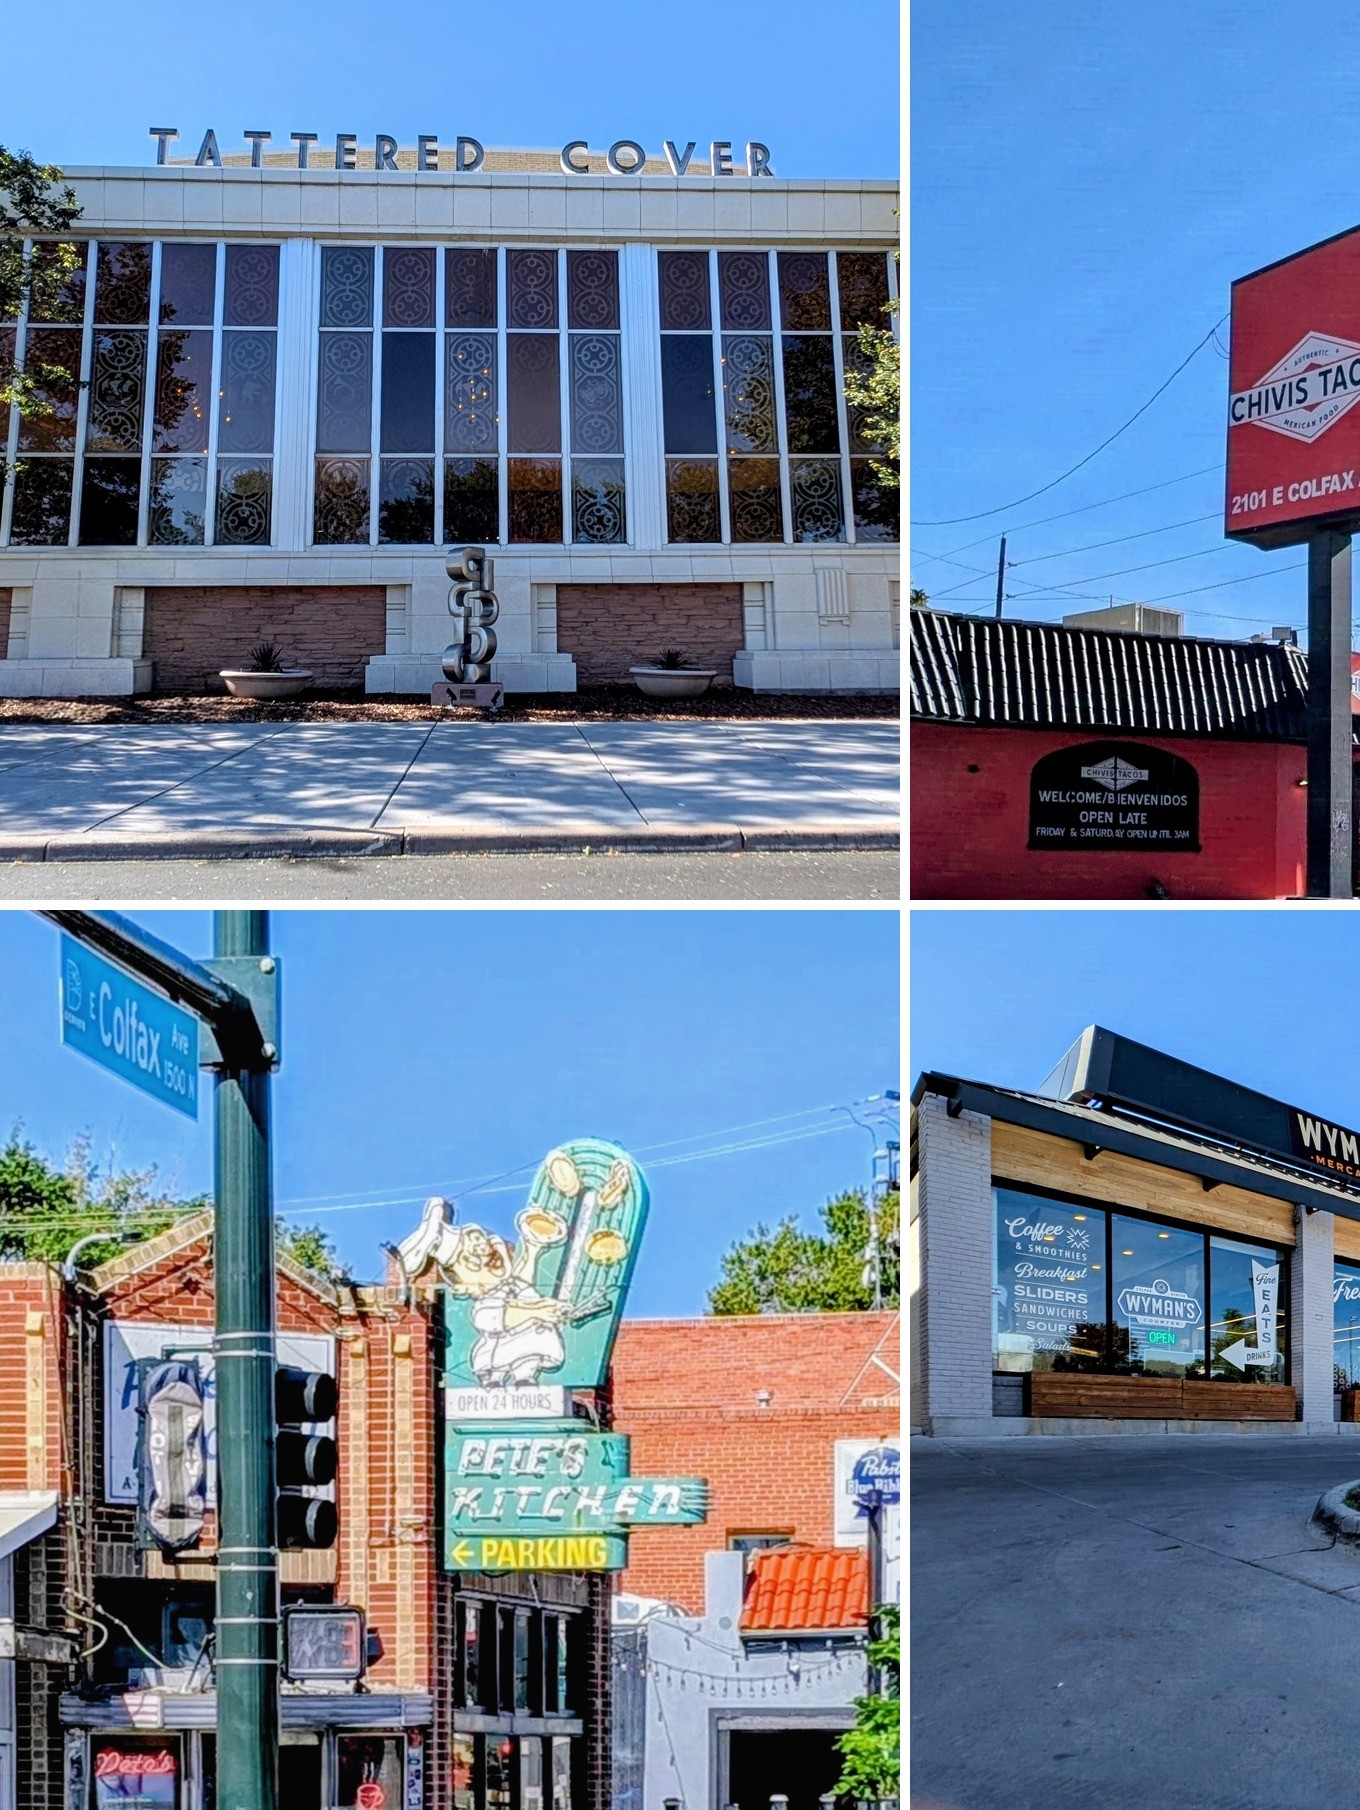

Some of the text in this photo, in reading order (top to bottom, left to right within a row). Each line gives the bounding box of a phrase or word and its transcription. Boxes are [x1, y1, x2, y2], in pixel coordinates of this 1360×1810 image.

[149, 127, 775, 177] TATTERED COVER
[1294, 349, 1329, 368] AUTHENTIC
[1231, 377, 1308, 423] CHIVIS
[1283, 403, 1340, 430] MEXICAN FOOD
[1231, 489, 1268, 516] 2101
[1272, 486, 1284, 506] E
[1287, 469, 1355, 503] COLFAX
[1086, 769, 1144, 779] CHIVIS TACOS
[1079, 811, 1148, 825] OPEN LATE
[1036, 827, 1065, 837] FRIDAY
[1070, 828, 1078, 837] &
[1127, 830, 1147, 839] OPEN
[1174, 830, 1190, 839] 3AM
[99, 980, 162, 1079] Colfax
[171, 1022, 190, 1056] Ave
[164, 1060, 186, 1096] 1500
[1004, 1217, 1063, 1242] Coffee
[1015, 1242, 1087, 1262] & SMOOTHIES
[1014, 1262, 1087, 1282] Breakfast
[1256, 1272, 1277, 1285] Fine
[1013, 1284, 1088, 1304] SLIDERS
[1013, 1302, 1088, 1320] SANDWICHES
[1126, 1294, 1195, 1319] WYMAN'S
[1261, 1289, 1271, 1344] EATS
[1026, 1321, 1077, 1333] SOUPS
[1143, 1317, 1181, 1326] COUNTER
[1149, 1332, 1175, 1344] OPEN
[1246, 1352, 1271, 1362] DRINKS
[457, 1393, 553, 1412] OPEN 24 HOURS
[457, 1437, 590, 1478] PETE'S
[859, 1455, 900, 1477] Pabst
[450, 1485, 682, 1519] KITCHEN
[481, 1538, 608, 1569] PARKING
